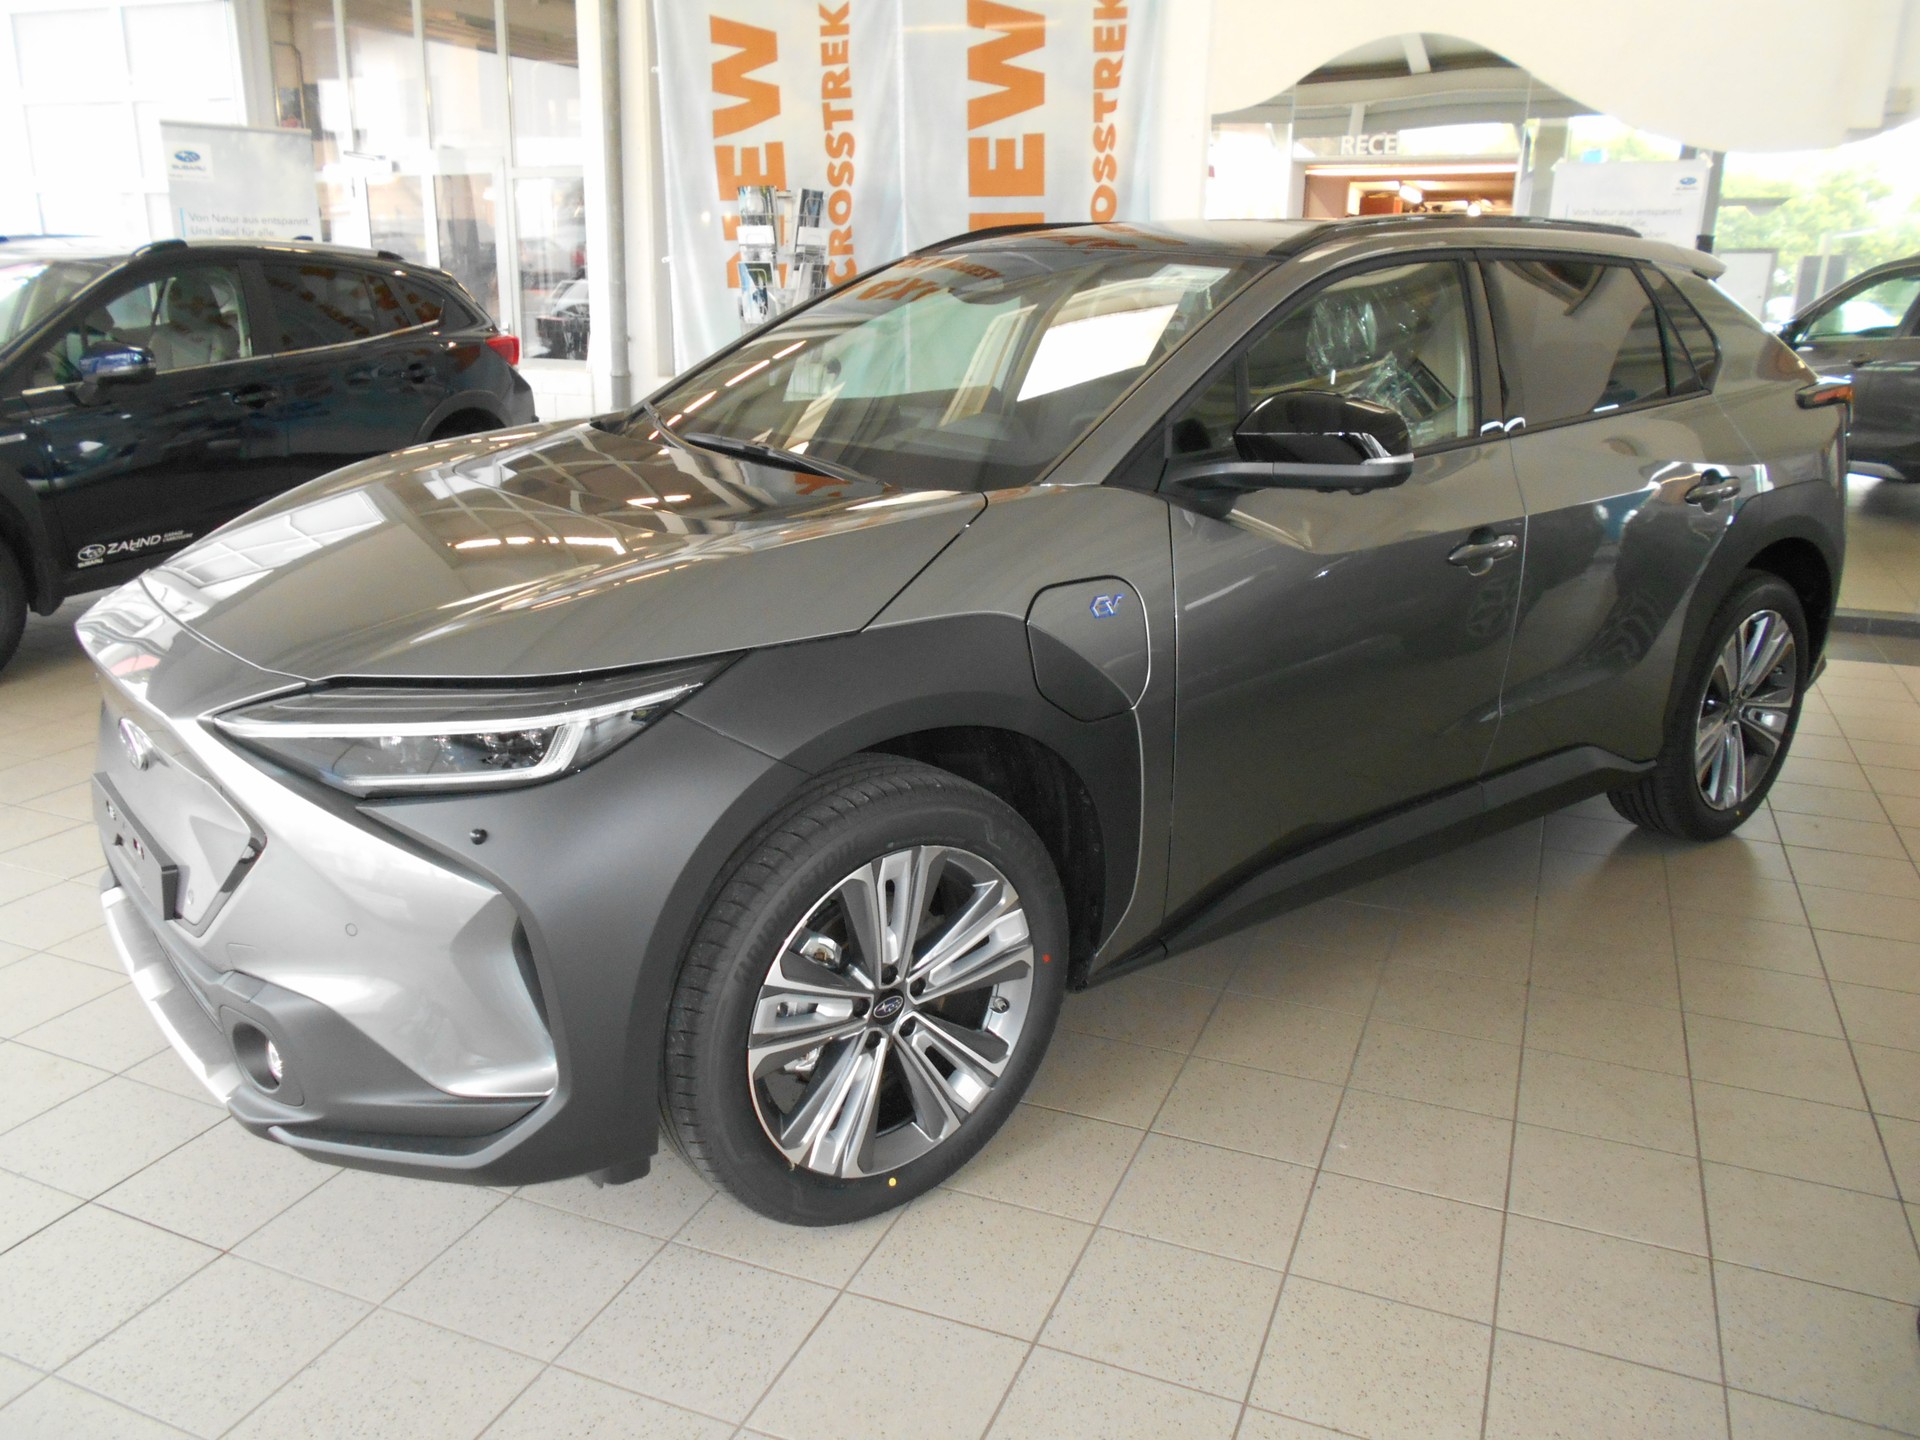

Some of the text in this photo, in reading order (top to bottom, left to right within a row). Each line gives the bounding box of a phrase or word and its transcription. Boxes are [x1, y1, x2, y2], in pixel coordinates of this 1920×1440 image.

[967, 0, 1046, 233] EW
[818, 1, 857, 287] CROSSTREK
[1340, 133, 1400, 155] RECE
[188, 212, 209, 222] Von
[212, 213, 239, 224] Natur
[242, 216, 258, 224] aus
[107, 535, 162, 554] ZAHND
